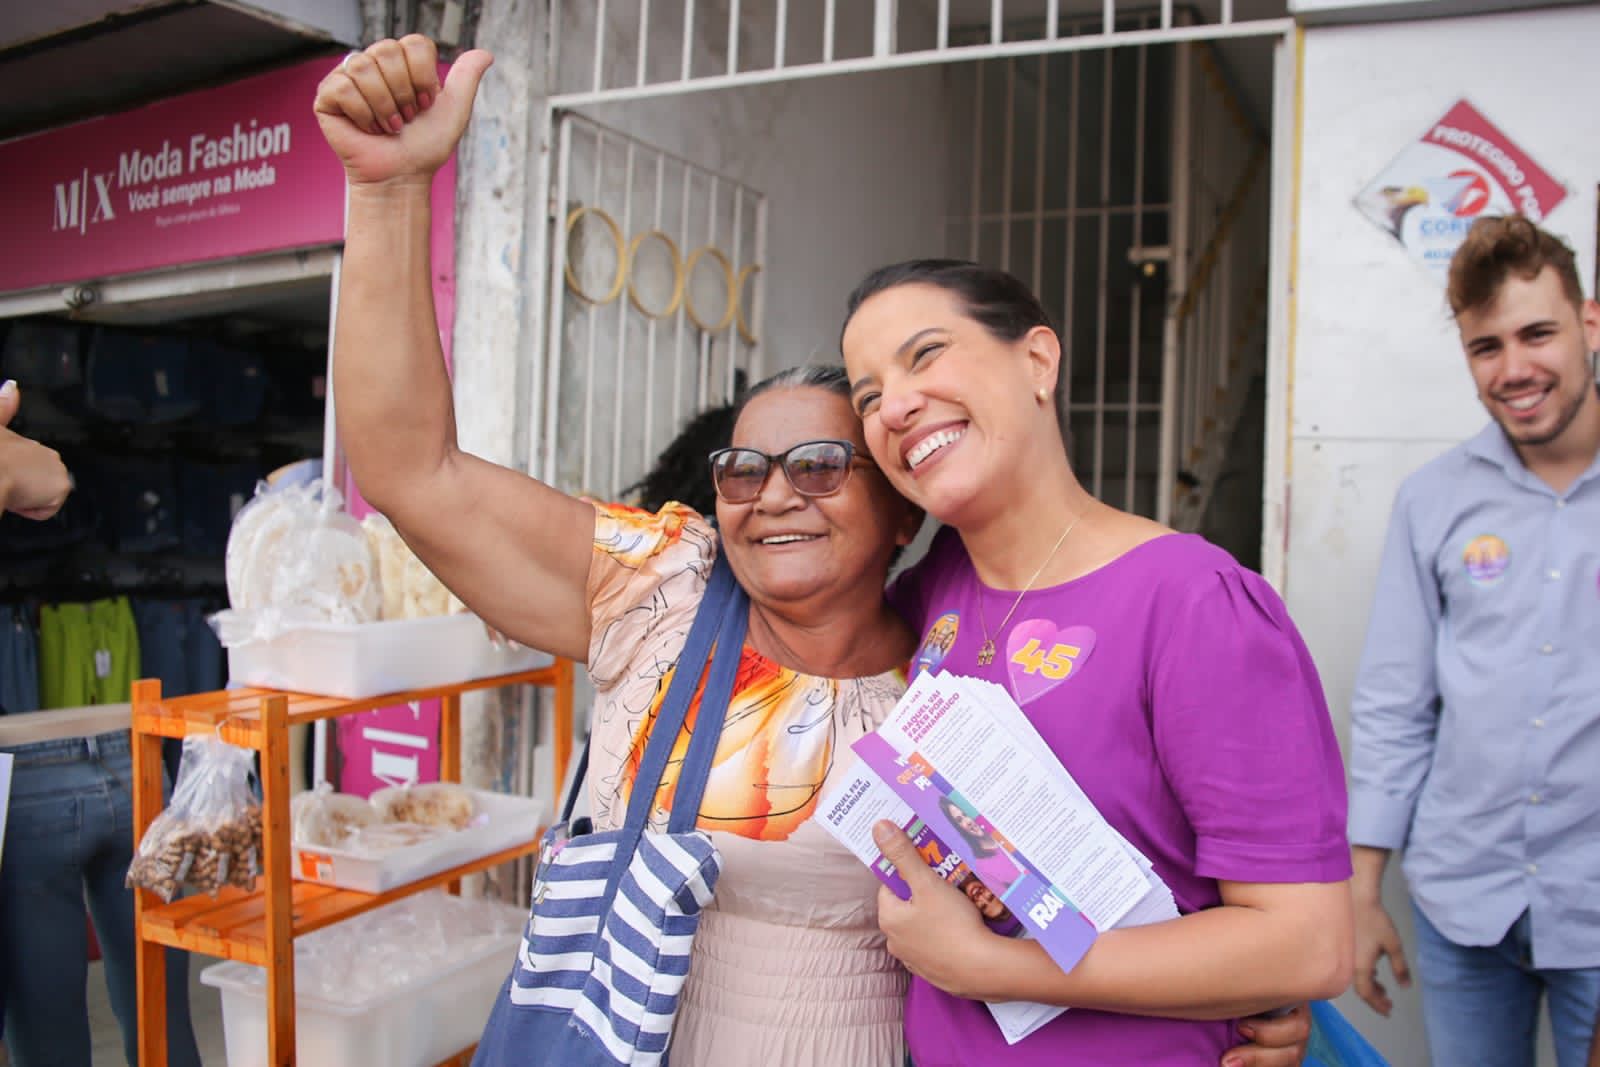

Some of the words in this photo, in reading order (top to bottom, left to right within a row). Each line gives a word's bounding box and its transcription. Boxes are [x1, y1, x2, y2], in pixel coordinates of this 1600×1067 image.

[118, 140, 182, 189] Moda
[189, 118, 291, 173] Fashion
[128, 186, 160, 213] Você
[162, 178, 210, 205] sempre
[214, 175, 232, 196] na
[234, 162, 276, 192] Moda
[1011, 638, 1081, 680] 45
[901, 703, 929, 733] RAQUEL
[927, 689, 941, 705] VAI
[913, 692, 960, 743] PERNAMBUCO
[928, 697, 945, 714] POR
[826, 793, 852, 820] RAQUEL
[849, 777, 863, 794] FEZ
[833, 815, 844, 826] EM
[842, 780, 872, 816] CARUARU
